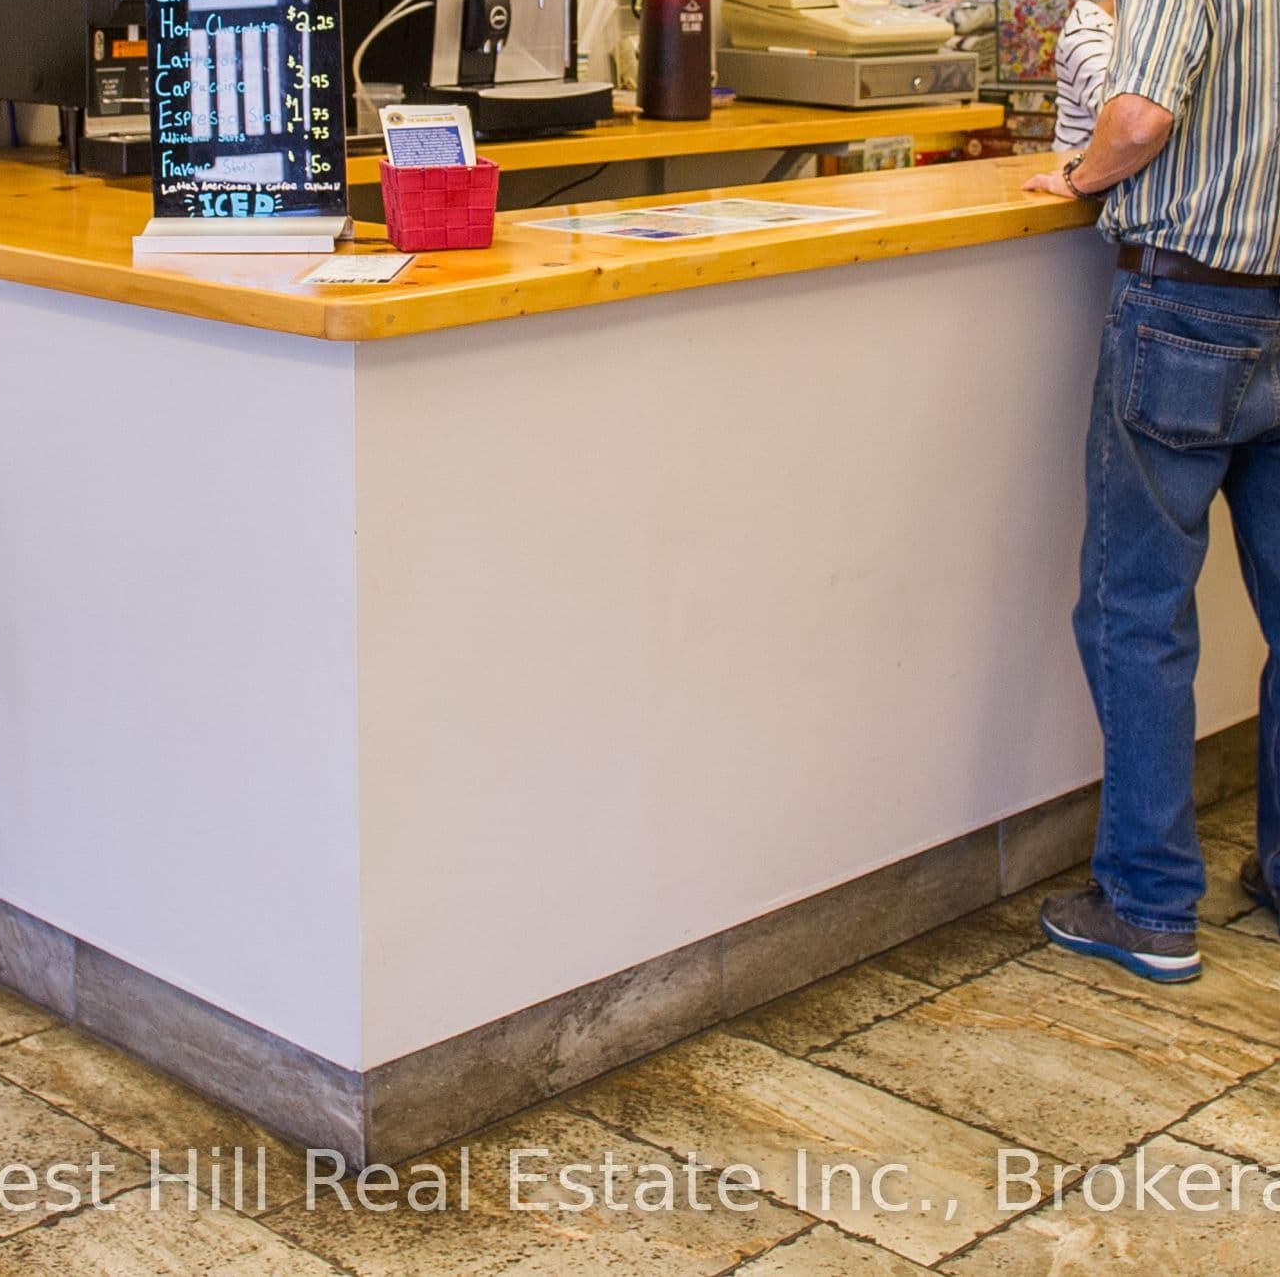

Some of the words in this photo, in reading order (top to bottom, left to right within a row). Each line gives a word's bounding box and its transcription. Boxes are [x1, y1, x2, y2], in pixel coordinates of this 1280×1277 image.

[161, 8, 192, 39] Hot
[205, 13, 277, 36] Chocolate
[286, 6, 335, 32] $2.25
[156, 43, 215, 69] Latte
[287, 55, 330, 90] $3.95
[198, 192, 276, 217] ICED
